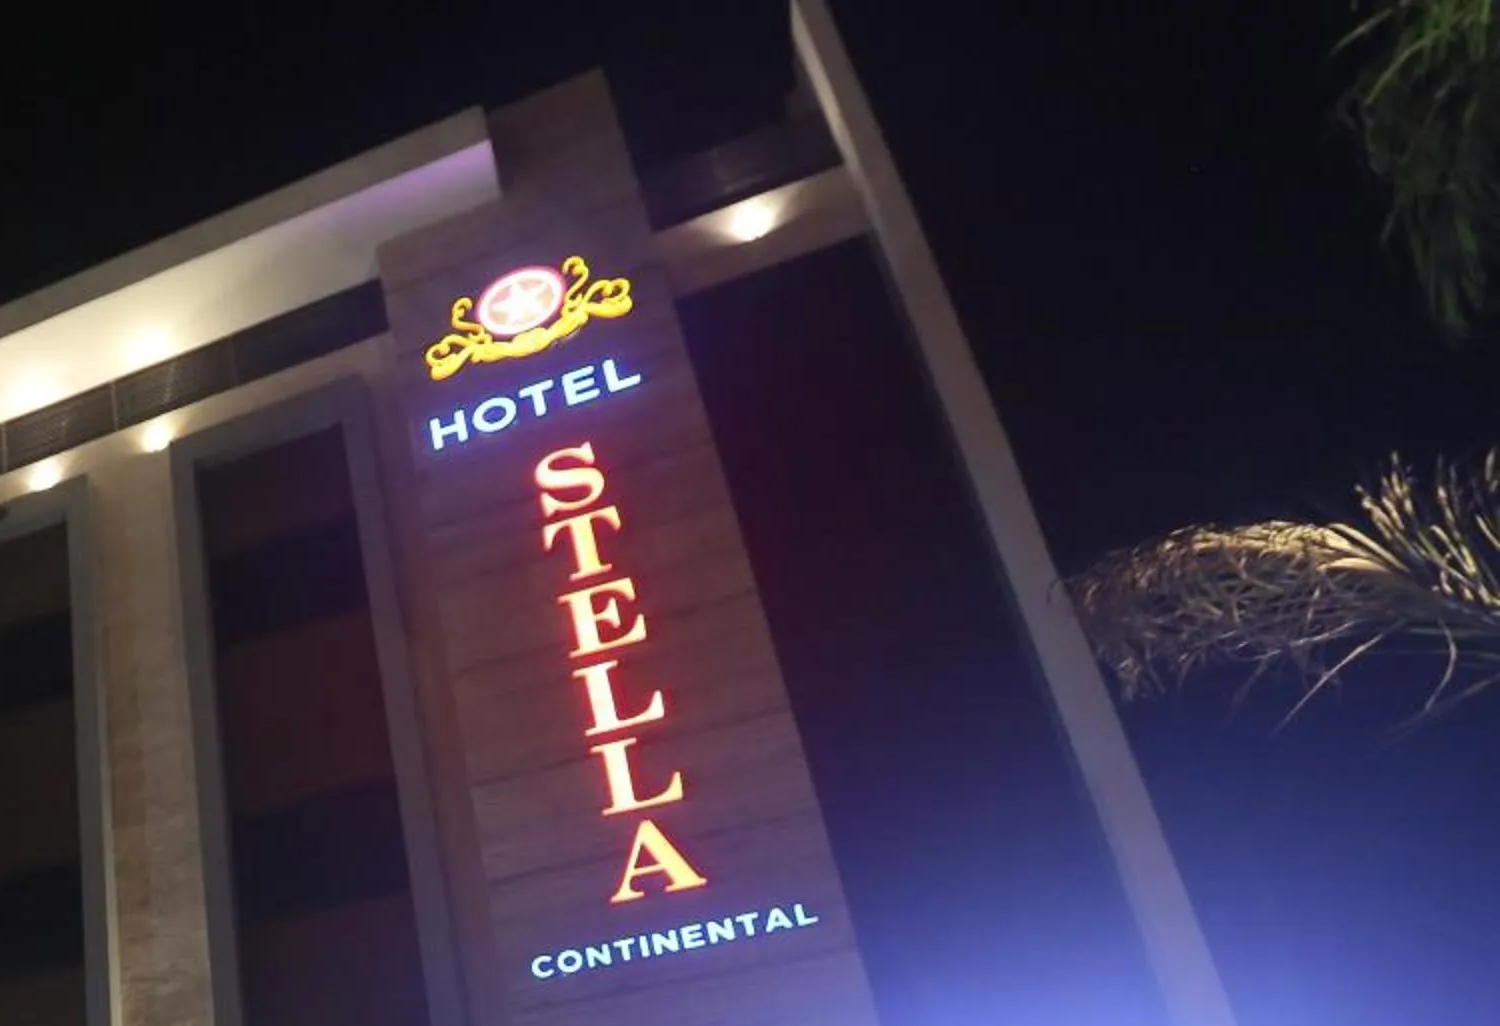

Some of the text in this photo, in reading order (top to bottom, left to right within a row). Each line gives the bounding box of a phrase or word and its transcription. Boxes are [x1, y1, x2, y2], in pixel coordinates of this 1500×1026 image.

[429, 357, 642, 451] HOTEL
[533, 441, 707, 903] STELLA
[530, 902, 819, 979] CONTINENTAL
